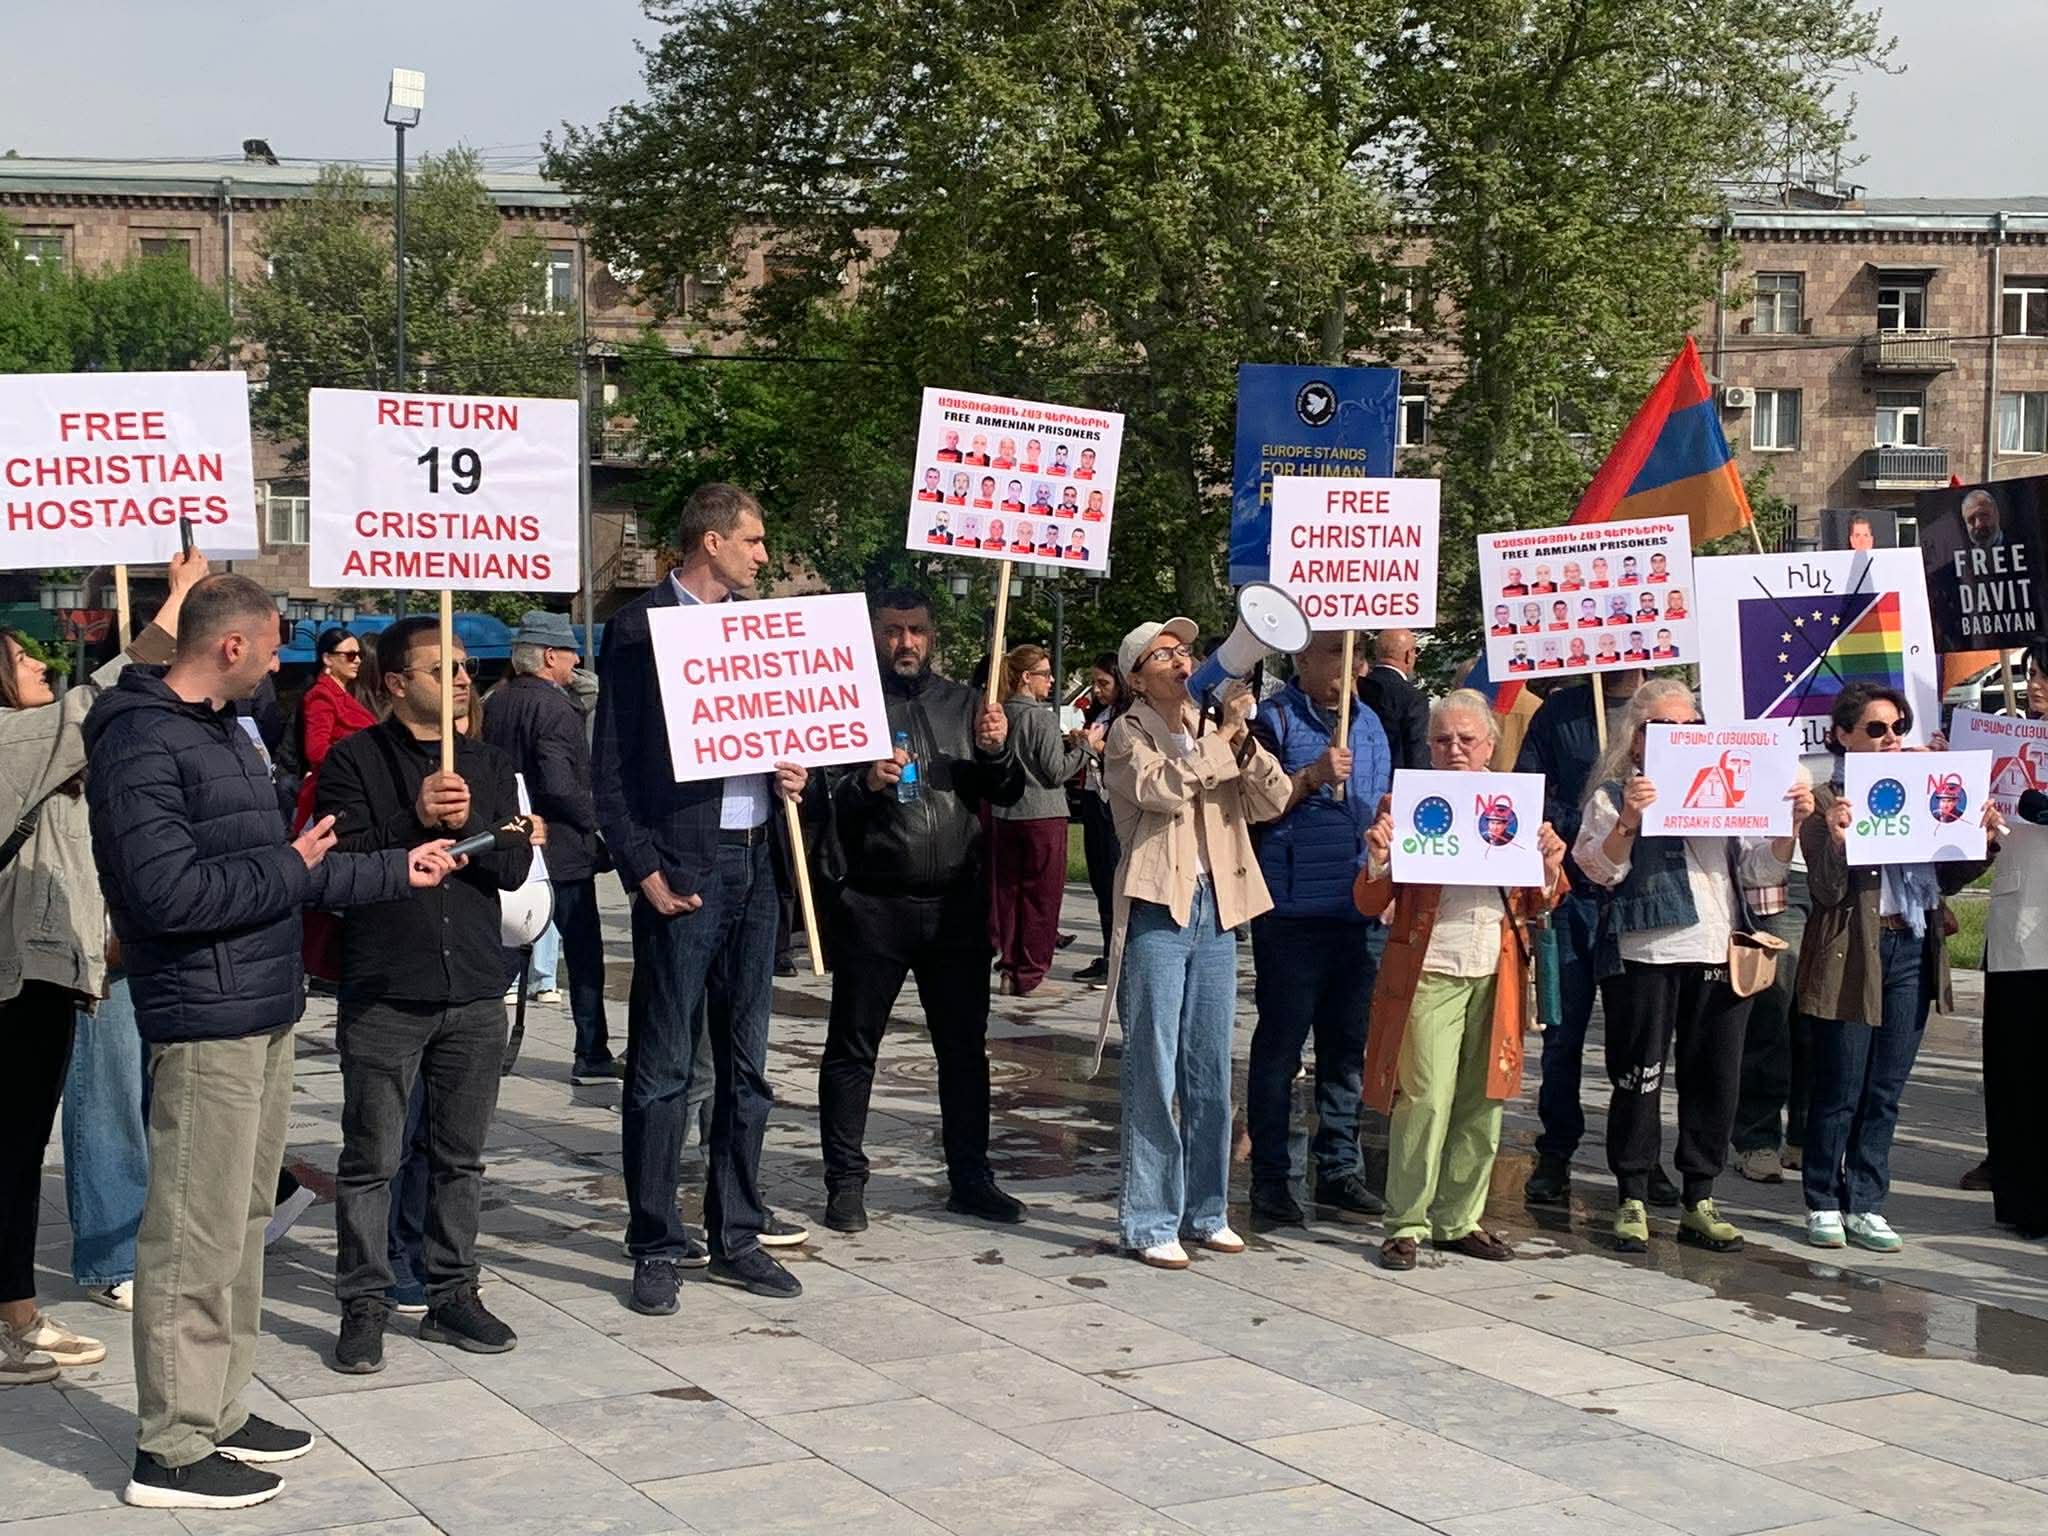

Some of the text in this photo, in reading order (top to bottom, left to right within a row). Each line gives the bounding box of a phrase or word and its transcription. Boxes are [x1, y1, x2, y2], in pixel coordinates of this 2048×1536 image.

[60, 411, 167, 442] FREE
[377, 399, 519, 431] RETURN
[944, 411, 1101, 441] FREE ARMENIAN PRISONERS
[1261, 444, 1368, 461] EUROPE STANDS
[5, 453, 223, 488] CHRISTIAN
[417, 446, 483, 495] 19
[1260, 461, 1296, 477] FOR
[7, 495, 229, 531] HOSTAGES
[1327, 490, 1390, 514] FREE
[355, 511, 540, 542] CRISTIANS
[1290, 525, 1421, 548] CHRISTIAN
[1502, 536, 1668, 560] FREE ARMENIAN PRISONERS
[1954, 544, 2027, 577] FREE
[342, 550, 551, 581] ARMENIANS
[1289, 559, 1419, 583] ARMENIAN
[1787, 563, 1834, 593] Ինչ
[1960, 579, 2031, 613] DAVIT
[722, 611, 806, 642] FREE
[1962, 611, 2036, 636] BABAYAN
[683, 646, 854, 685] CHRISTIAN
[692, 684, 860, 725] ARMENIAN
[694, 721, 868, 764] HOSTAGES
[1927, 773, 1963, 796] NO
[1475, 794, 1513, 817] NO
[1664, 815, 1769, 829] ARTSAKH IS ARMENIA
[1870, 814, 1911, 836] YES
[1416, 833, 1460, 857] YES
